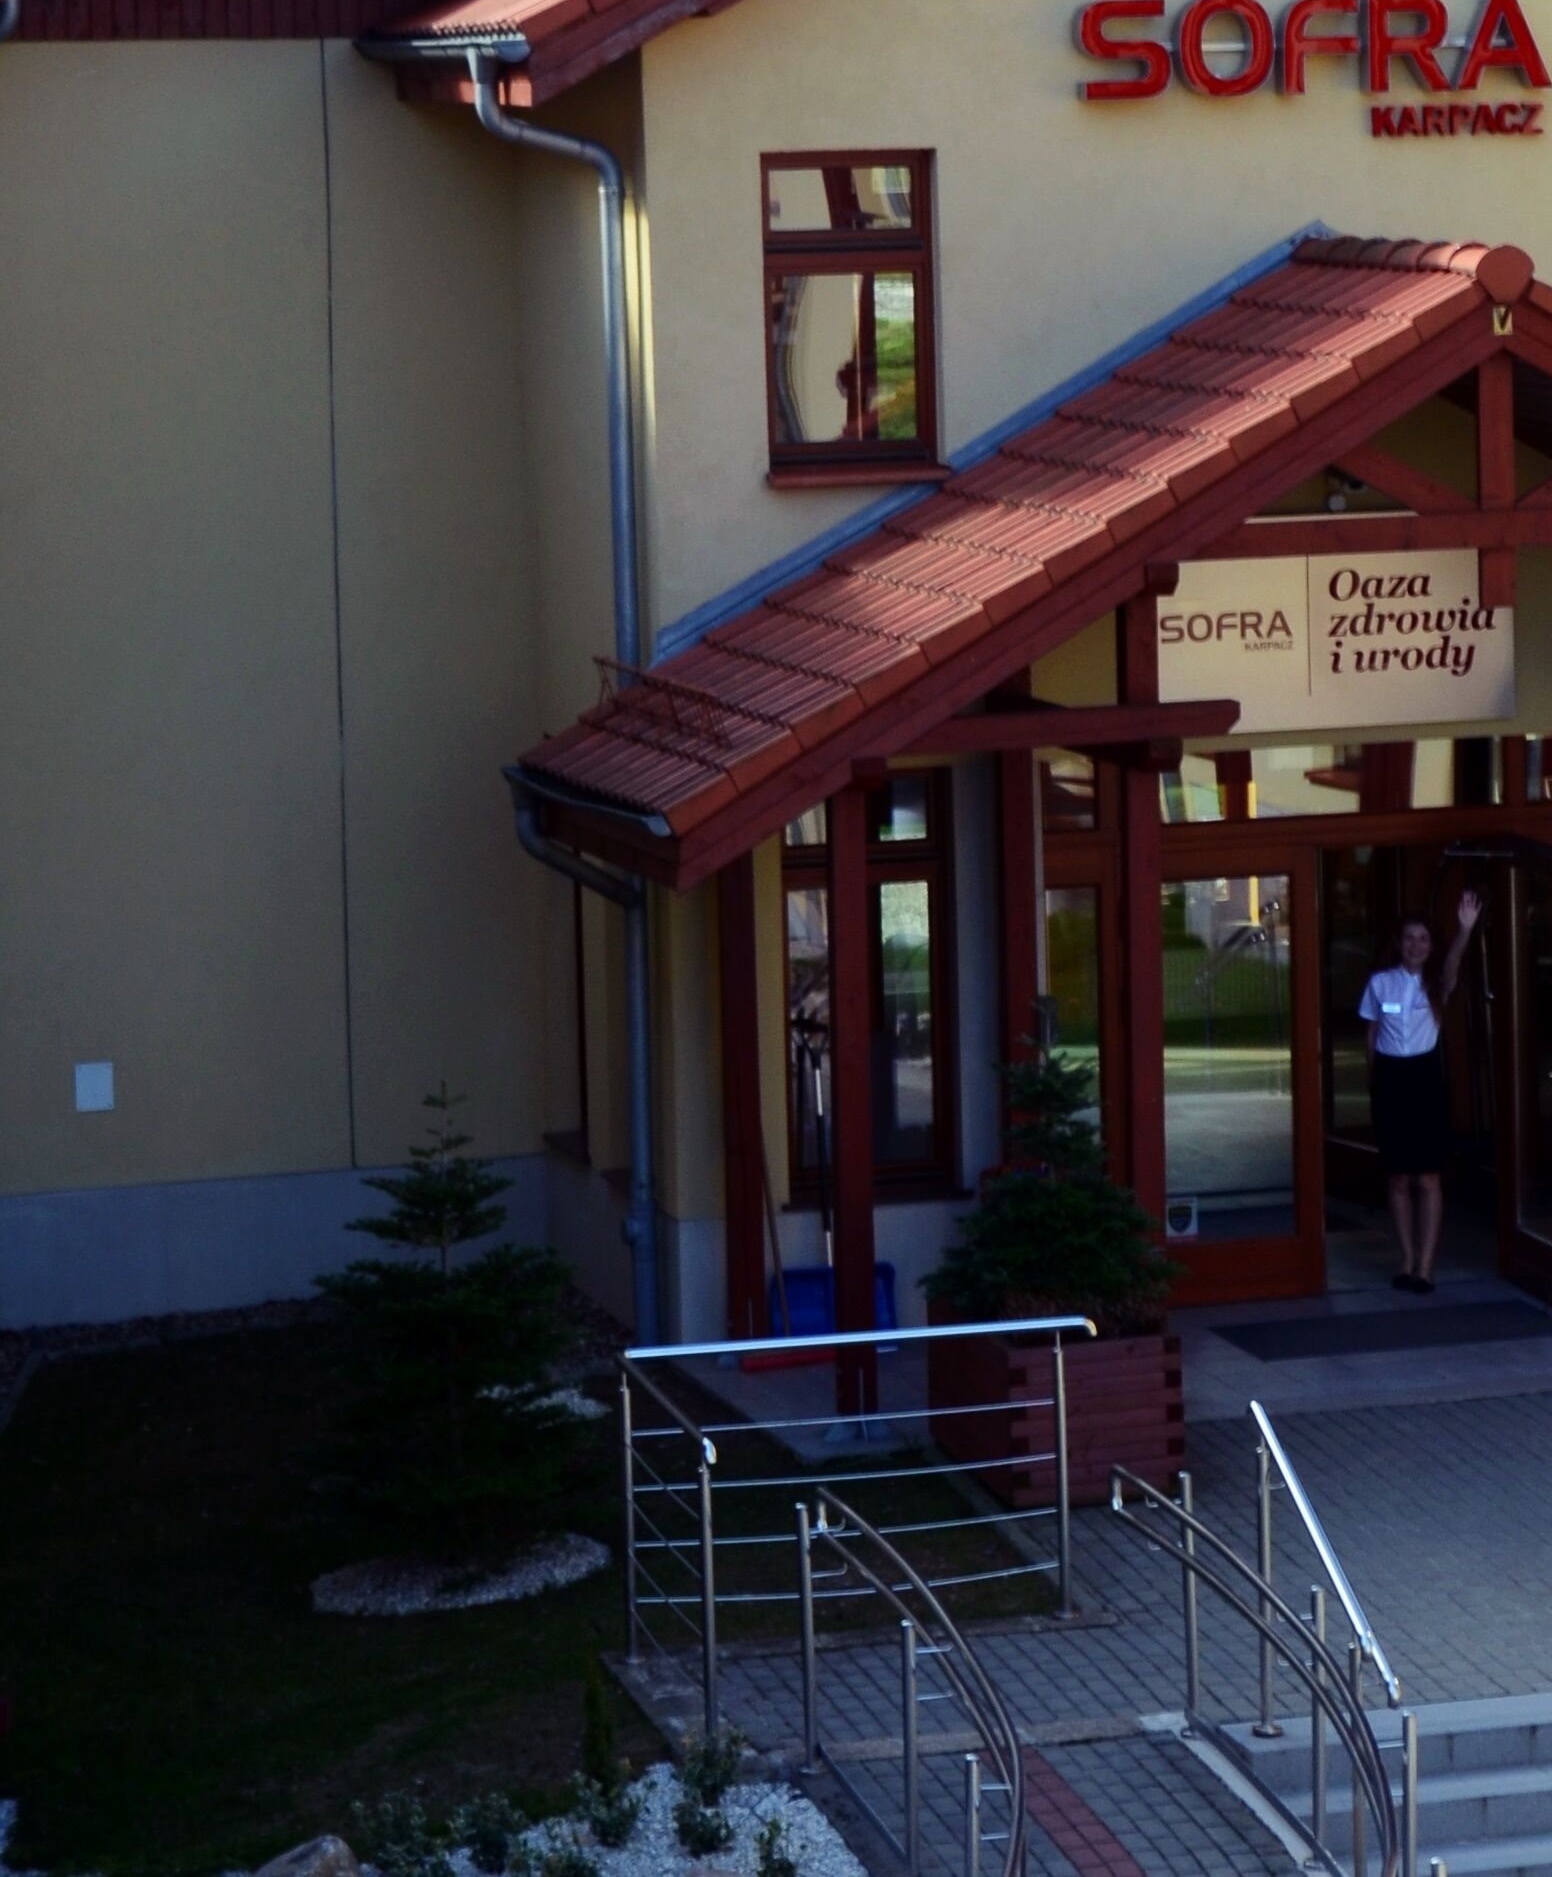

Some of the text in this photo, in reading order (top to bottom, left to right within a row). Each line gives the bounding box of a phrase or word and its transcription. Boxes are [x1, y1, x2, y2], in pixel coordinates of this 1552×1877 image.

[1370, 103, 1544, 139] KARPACZ
[1328, 568, 1432, 602] Oaza
[1160, 610, 1293, 644] SOFRA
[1328, 598, 1497, 638] zdrowia
[1330, 636, 1476, 677] i urody
